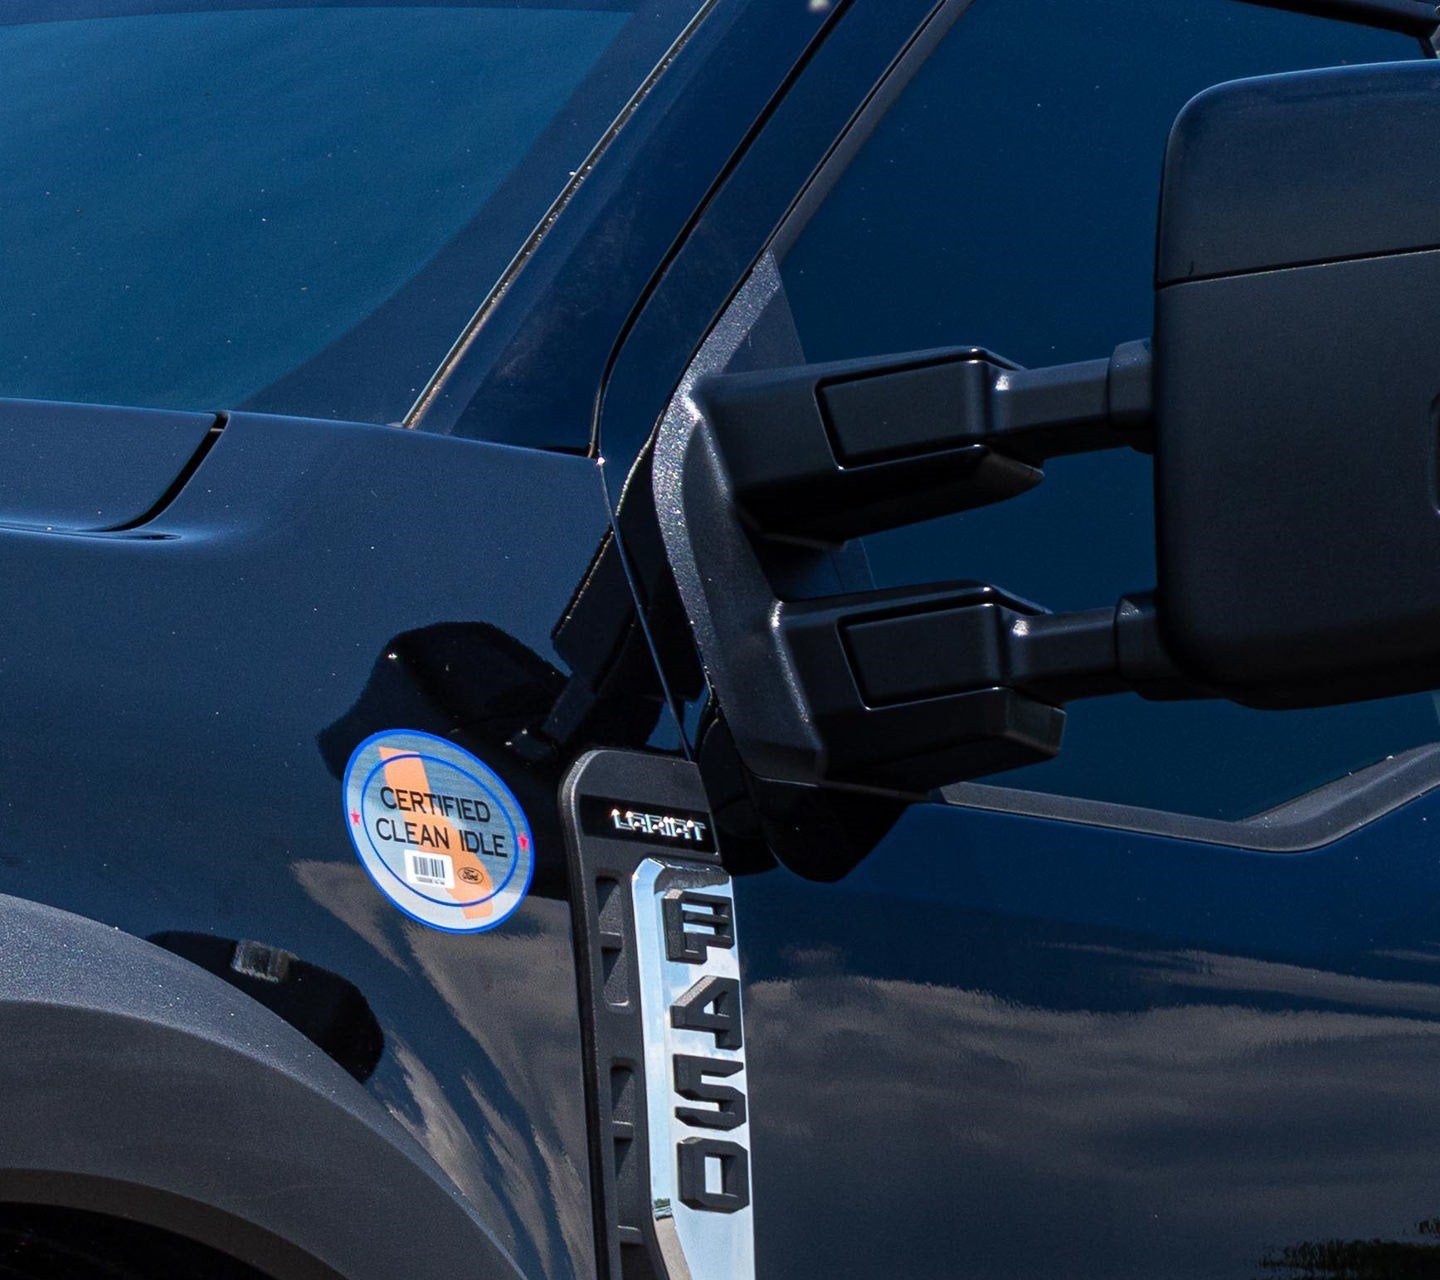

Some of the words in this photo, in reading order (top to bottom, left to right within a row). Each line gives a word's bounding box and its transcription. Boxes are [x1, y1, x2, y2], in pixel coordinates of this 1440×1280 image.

[380, 786, 491, 823] CERTIFIED
[375, 817, 450, 850] CLEAN
[460, 829, 508, 858] IDLE
[611, 808, 706, 841] LARIAT
[664, 889, 750, 1213] F450
